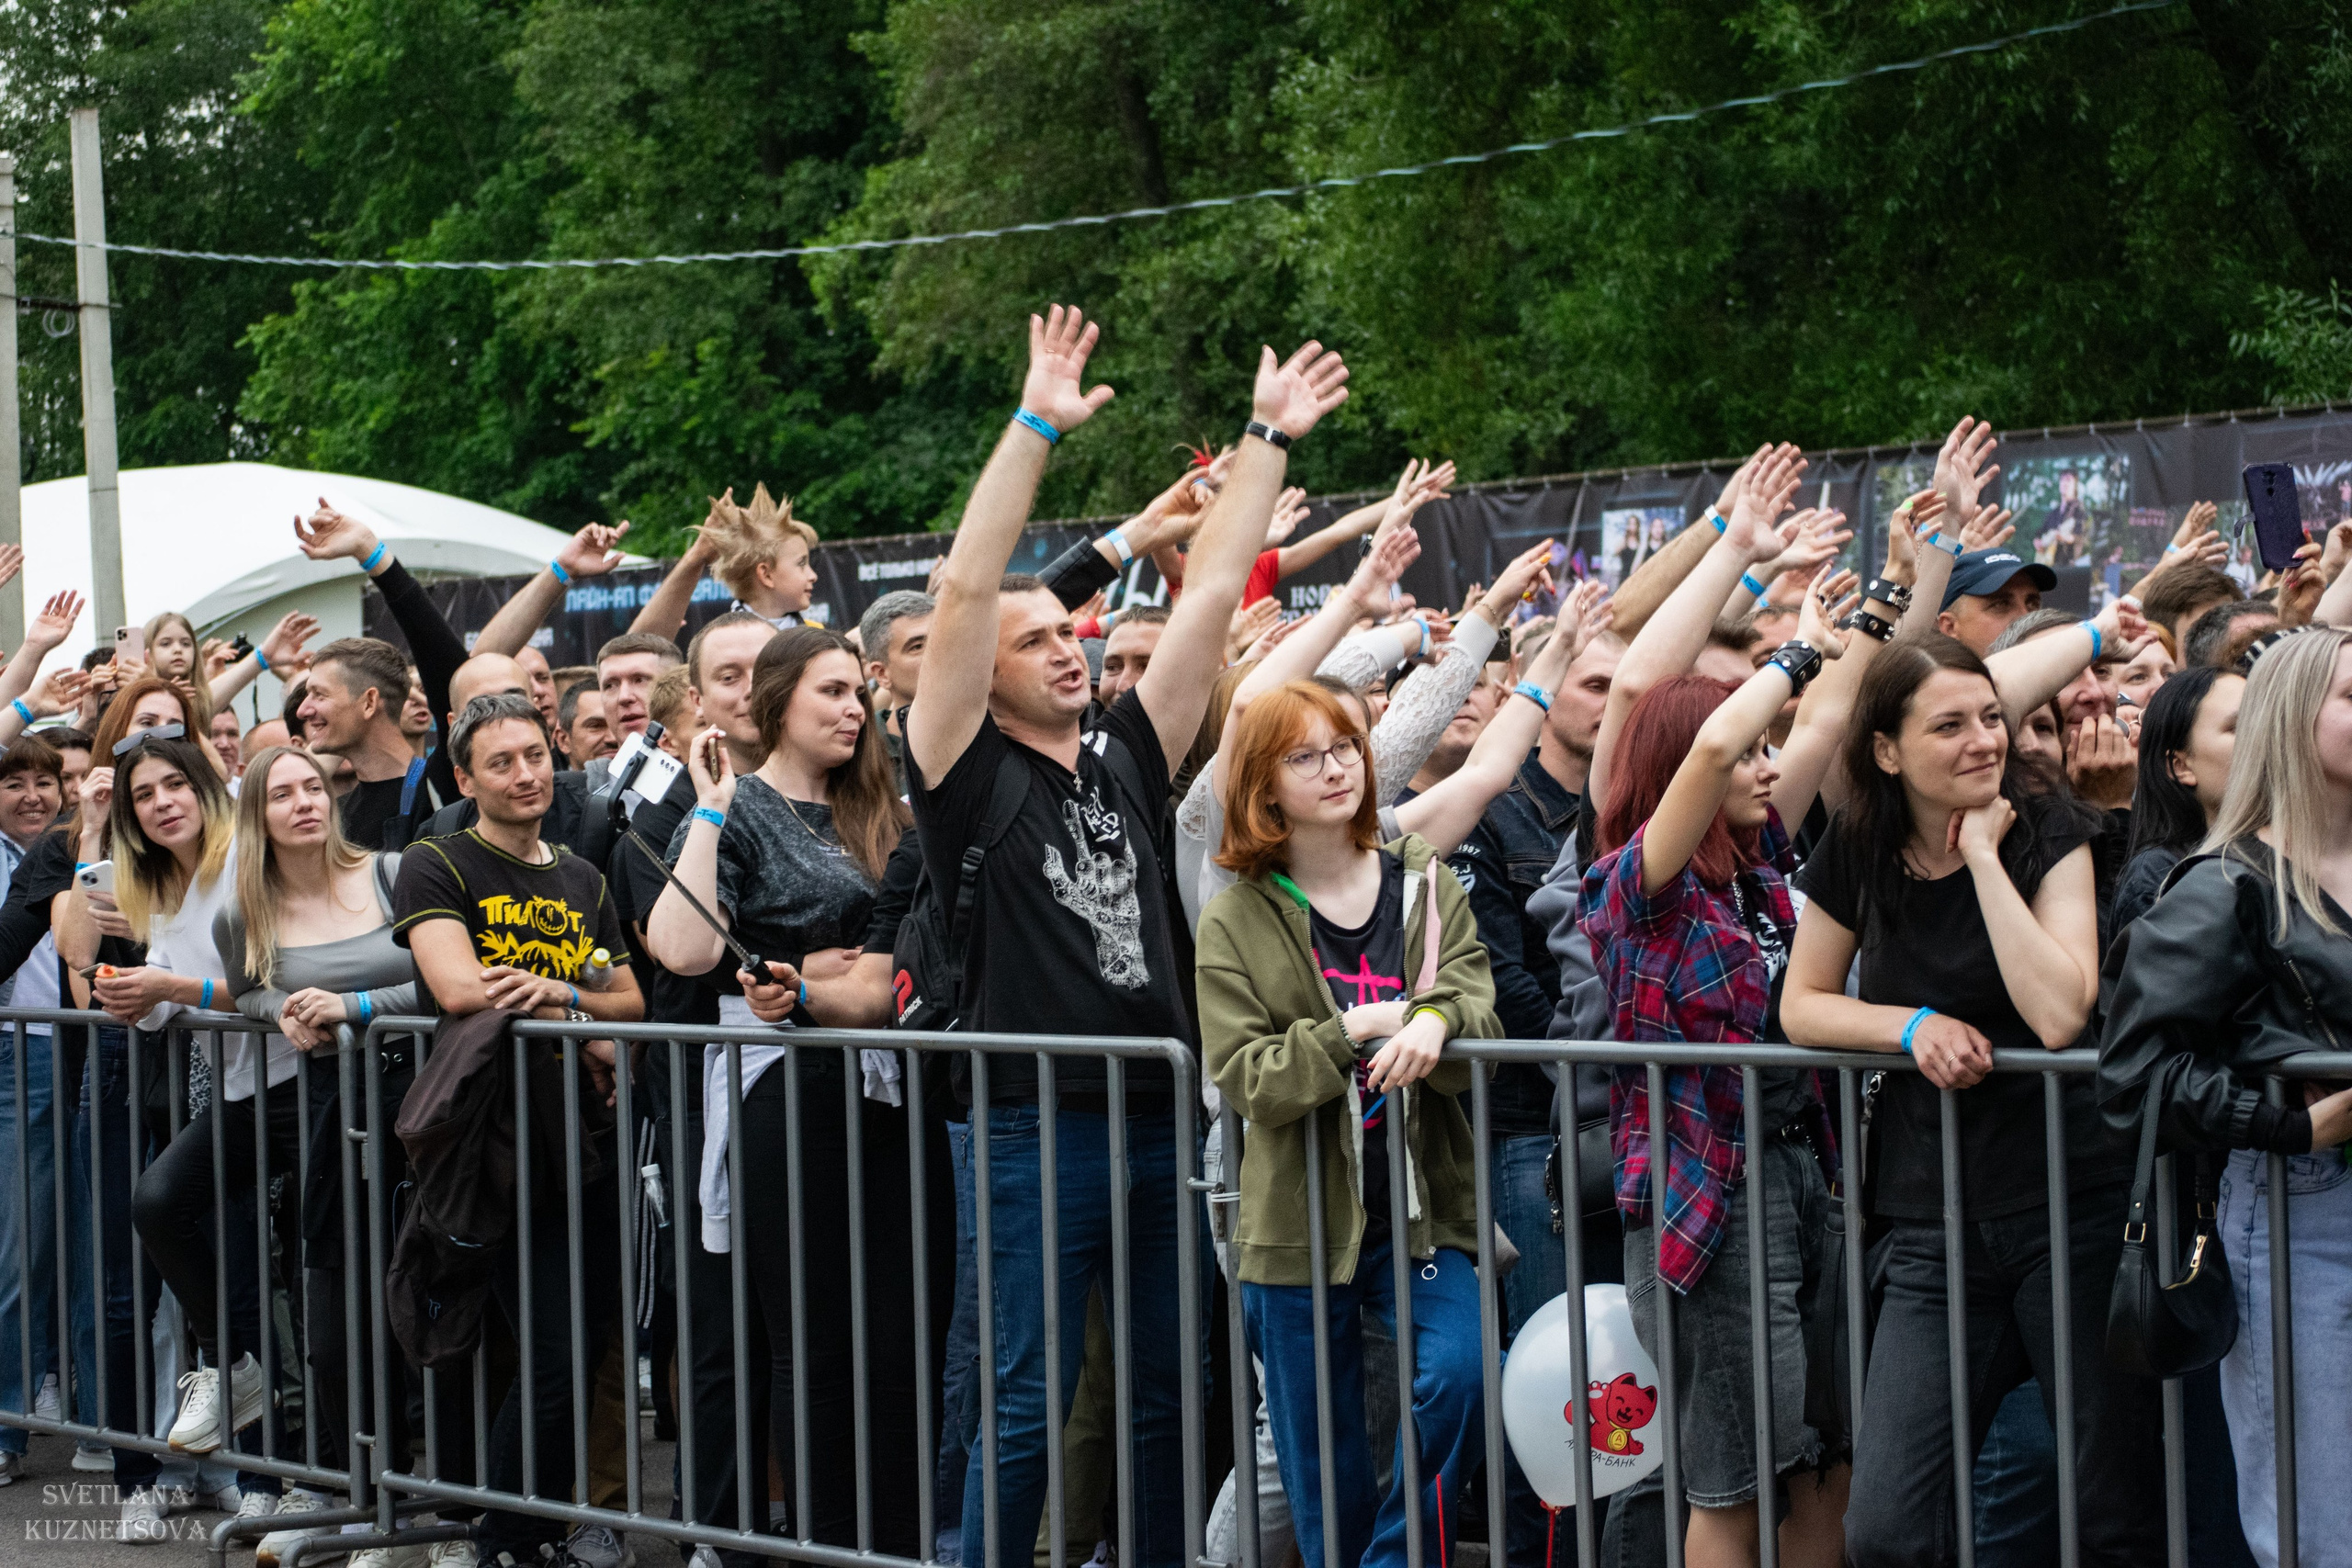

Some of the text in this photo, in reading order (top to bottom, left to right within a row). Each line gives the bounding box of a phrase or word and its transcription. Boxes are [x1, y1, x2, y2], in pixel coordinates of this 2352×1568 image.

[1458, 843, 1481, 855] 1987
[899, 995, 923, 1027] PATRICK
[1564, 1438, 1636, 1468] АА-БАНК
